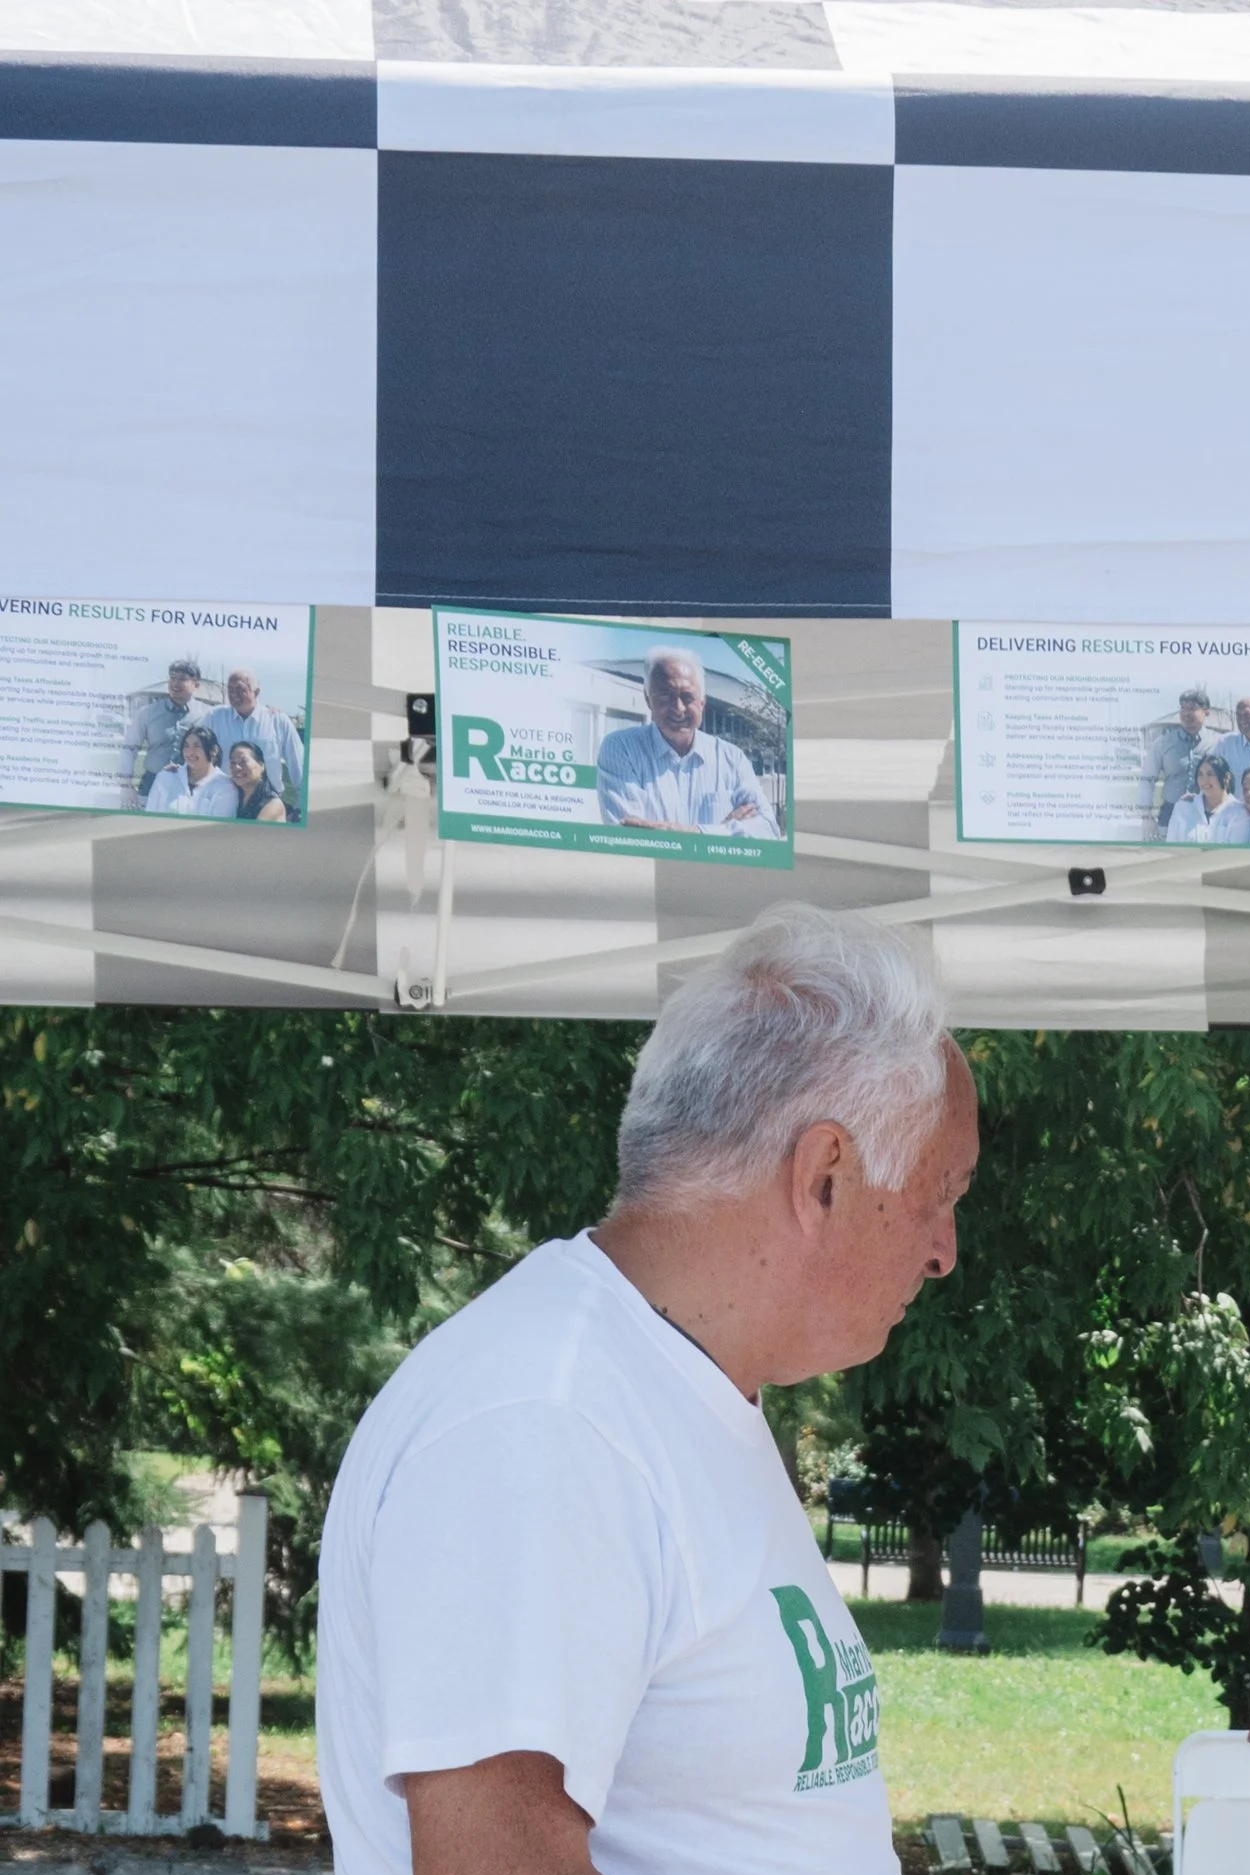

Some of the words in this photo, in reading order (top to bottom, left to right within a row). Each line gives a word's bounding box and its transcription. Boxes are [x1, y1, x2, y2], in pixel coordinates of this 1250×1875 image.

[68, 602, 145, 622] RESULTS
[150, 608, 185, 625] FOR
[190, 611, 278, 631] VAUGHAN
[446, 623, 526, 642] RELIABLE.
[447, 639, 561, 661] RESPONSIBLE.
[977, 636, 1075, 652] DELIVERING
[1082, 638, 1154, 654] RESULTS
[1160, 640, 1192, 655] FOR
[447, 656, 552, 677] RESPONSIVE.
[738, 640, 785, 689] RE-ELECT
[510, 727, 544, 742] VOTE
[547, 730, 572, 744] FOR
[509, 744, 555, 760] Mario
[562, 748, 577, 762] G.
[464, 787, 502, 797] CANDIDATE
[505, 790, 518, 798] FOR
[520, 791, 542, 800] LOCAL
[551, 794, 584, 804] REGIONAL
[477, 798, 521, 808] COUNCILLOR
[539, 803, 572, 812] VAUGHAN
[471, 823, 562, 839] WWW.MARIOGRACCO.CA
[794, 1769, 836, 1792] RELIABLE.
